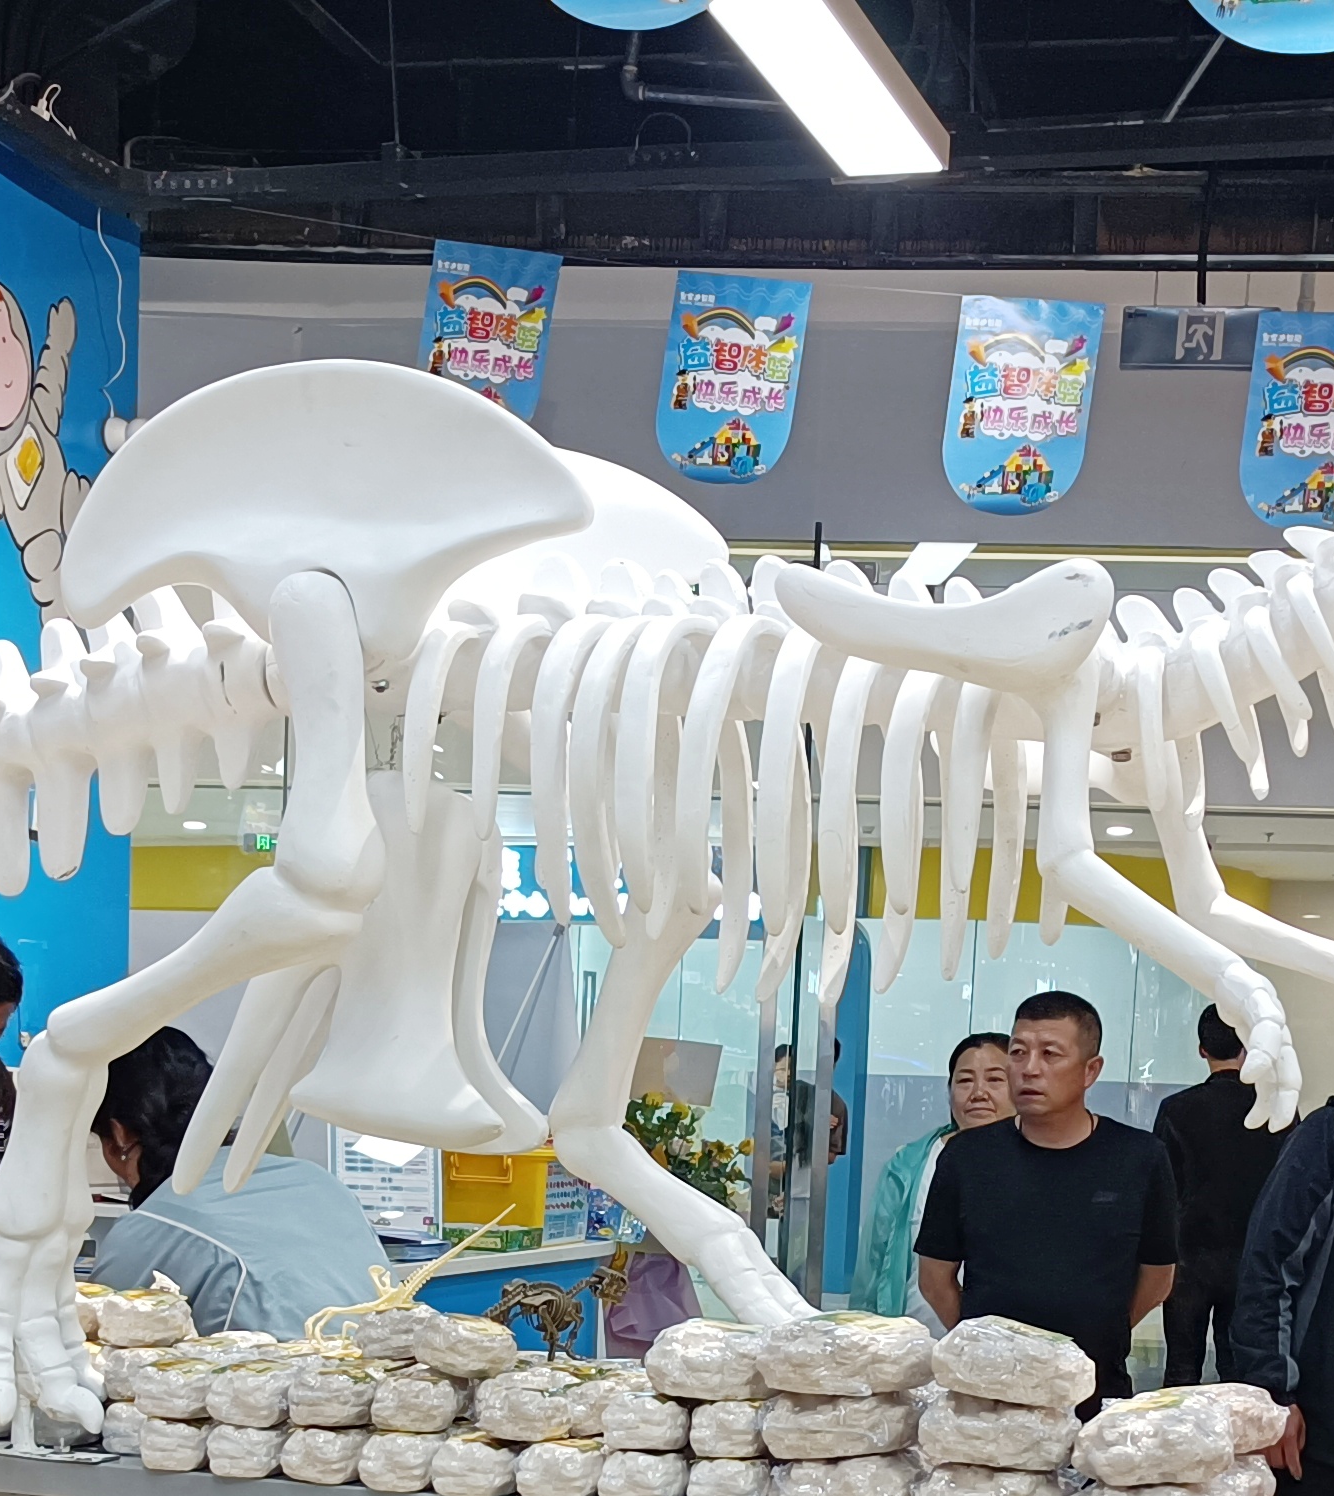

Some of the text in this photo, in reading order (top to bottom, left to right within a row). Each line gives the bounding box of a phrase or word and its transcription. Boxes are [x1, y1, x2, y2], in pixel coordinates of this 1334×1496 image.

[437, 305, 541, 351] 益智体验
[450, 347, 534, 379] 快乐成长
[680, 337, 790, 382] 益智体验
[696, 379, 786, 411] 快乐成长
[967, 363, 1084, 406] 益智体验
[983, 405, 1078, 435] 快乐成长
